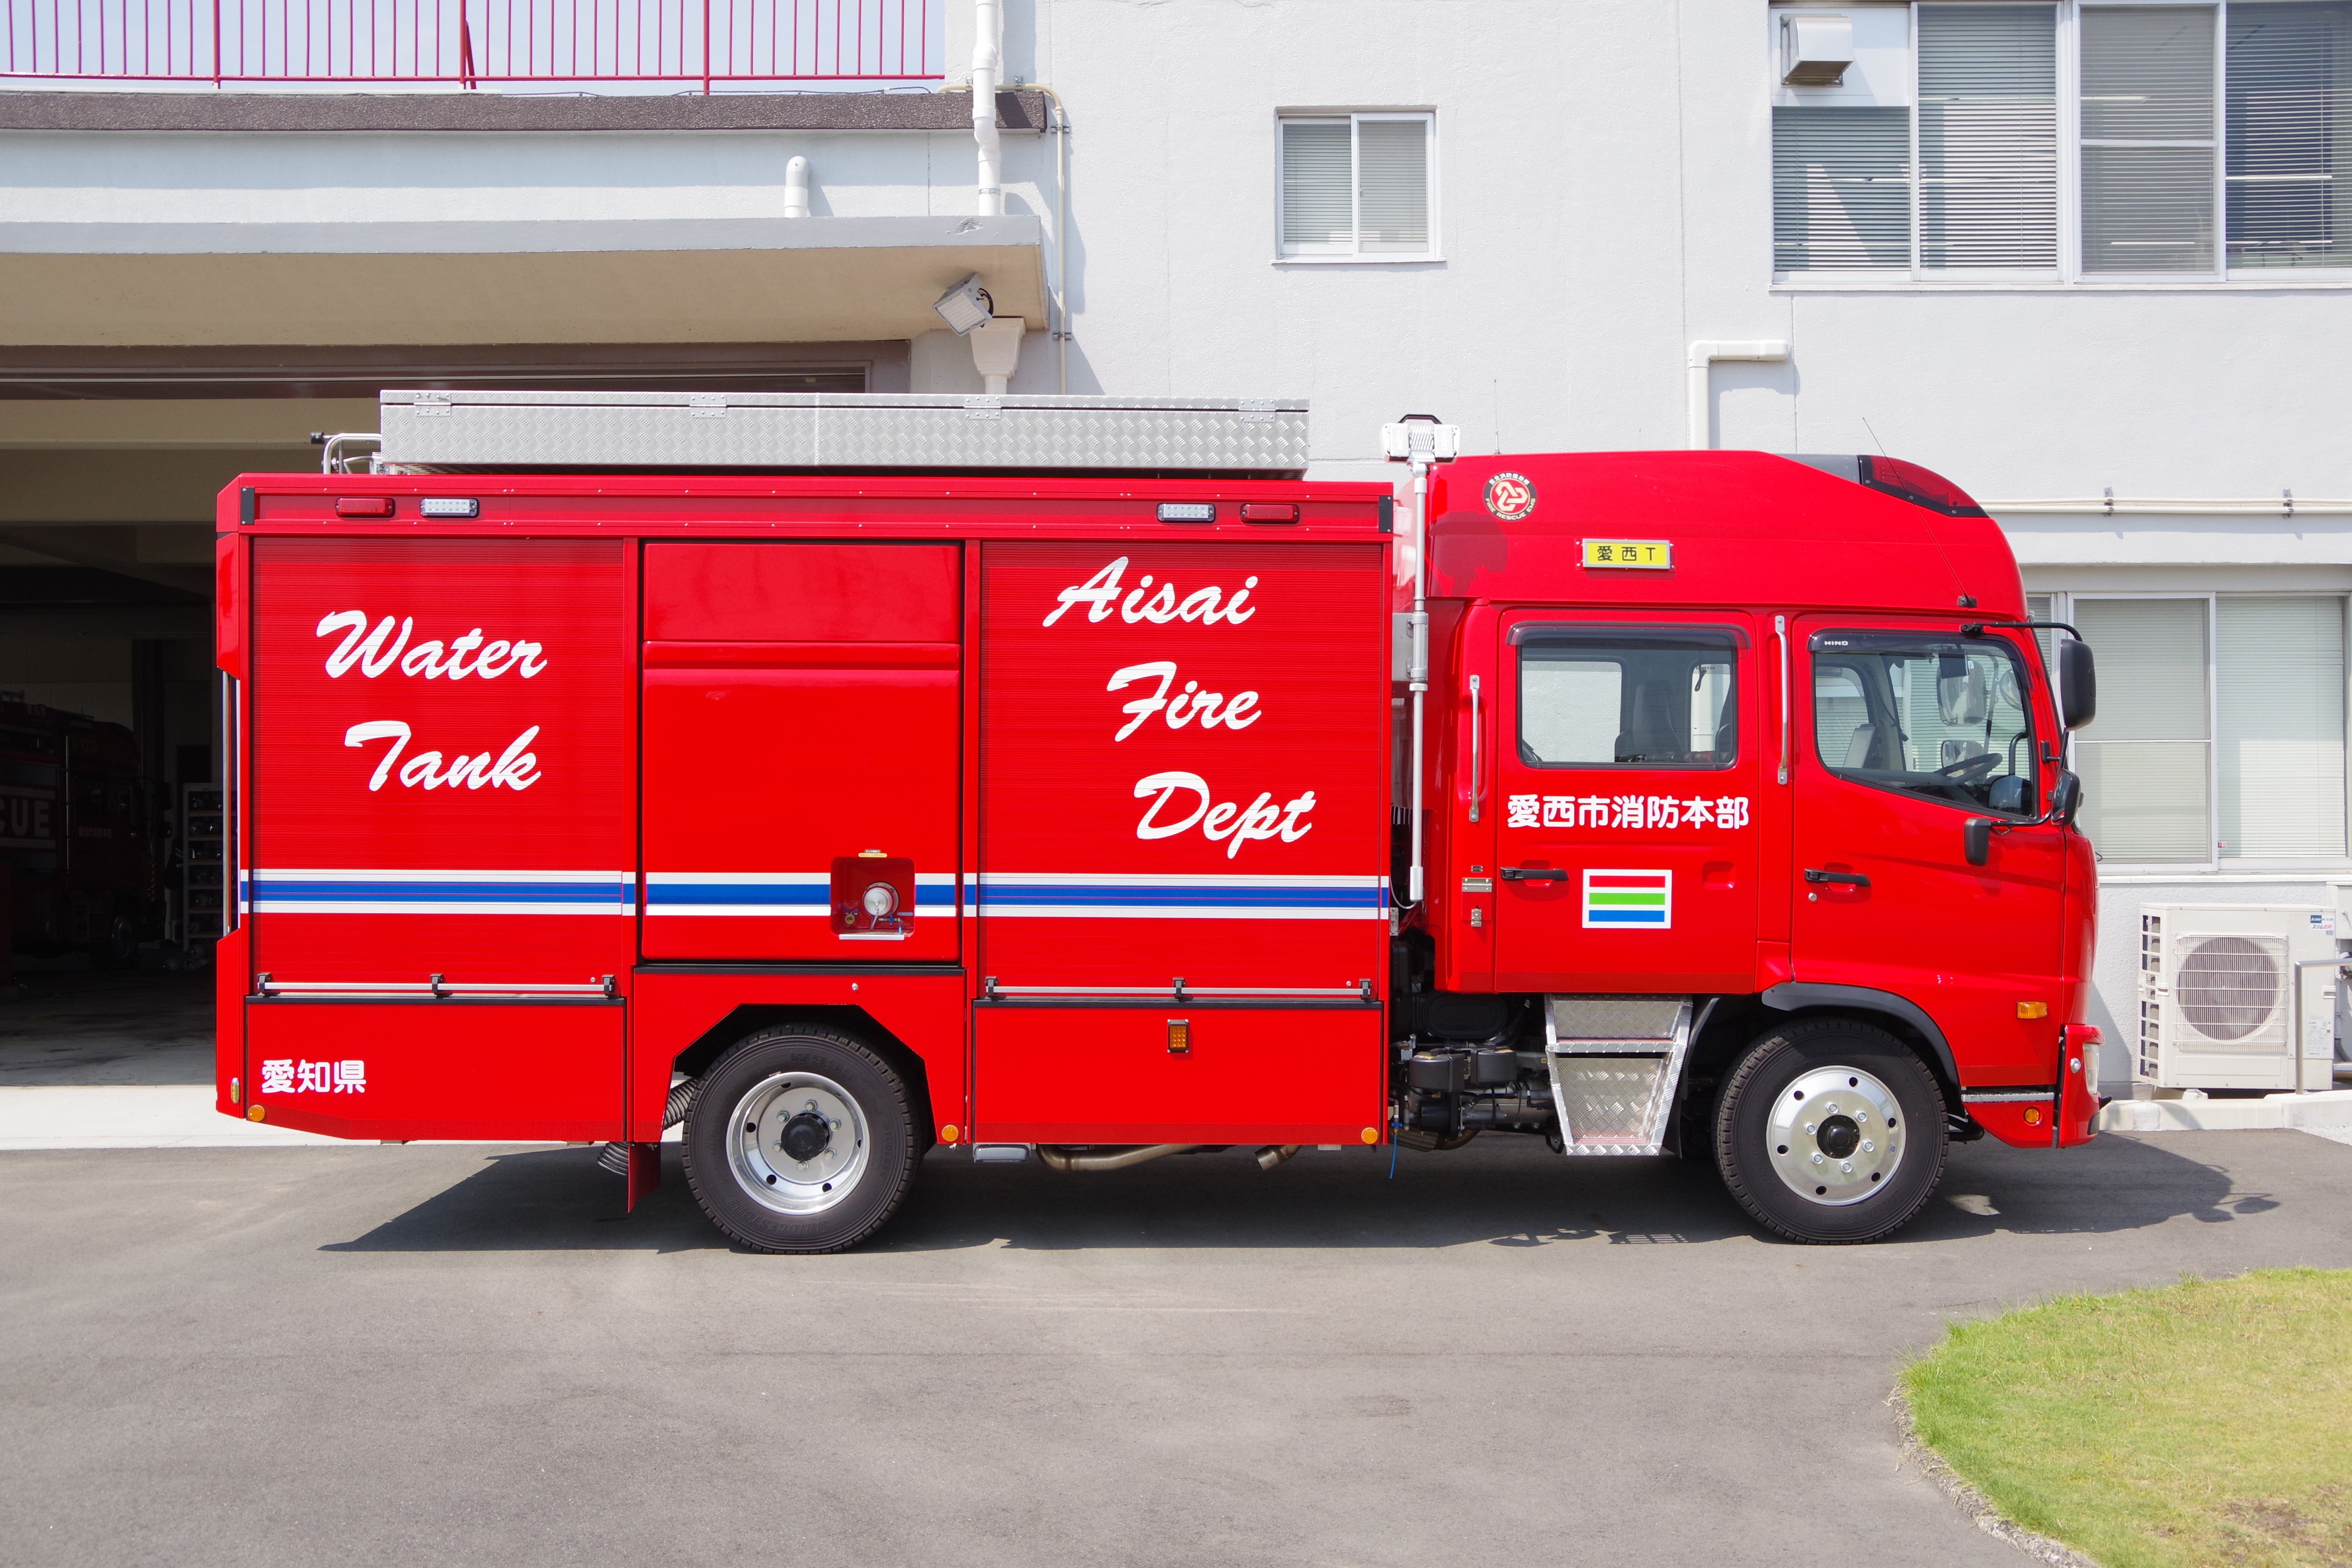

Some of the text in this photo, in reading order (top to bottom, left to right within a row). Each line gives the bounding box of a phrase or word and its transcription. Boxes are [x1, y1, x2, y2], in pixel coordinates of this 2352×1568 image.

[1485, 498, 1536, 520] FIRE RESCUE EMS
[1597, 546, 1656, 561] 愛西T
[1043, 556, 1258, 627] Aisai
[316, 610, 547, 680] Water
[1107, 662, 1261, 742] Fire
[345, 721, 541, 791] Tank
[1134, 772, 1316, 859] Dept
[1507, 794, 1749, 829] 愛西市消防本部
[262, 1059, 366, 1094] 愛知県
[728, 1197, 830, 1234] BRIDGESTONE
[1802, 1187, 1905, 1226] BRIDGESTONE
